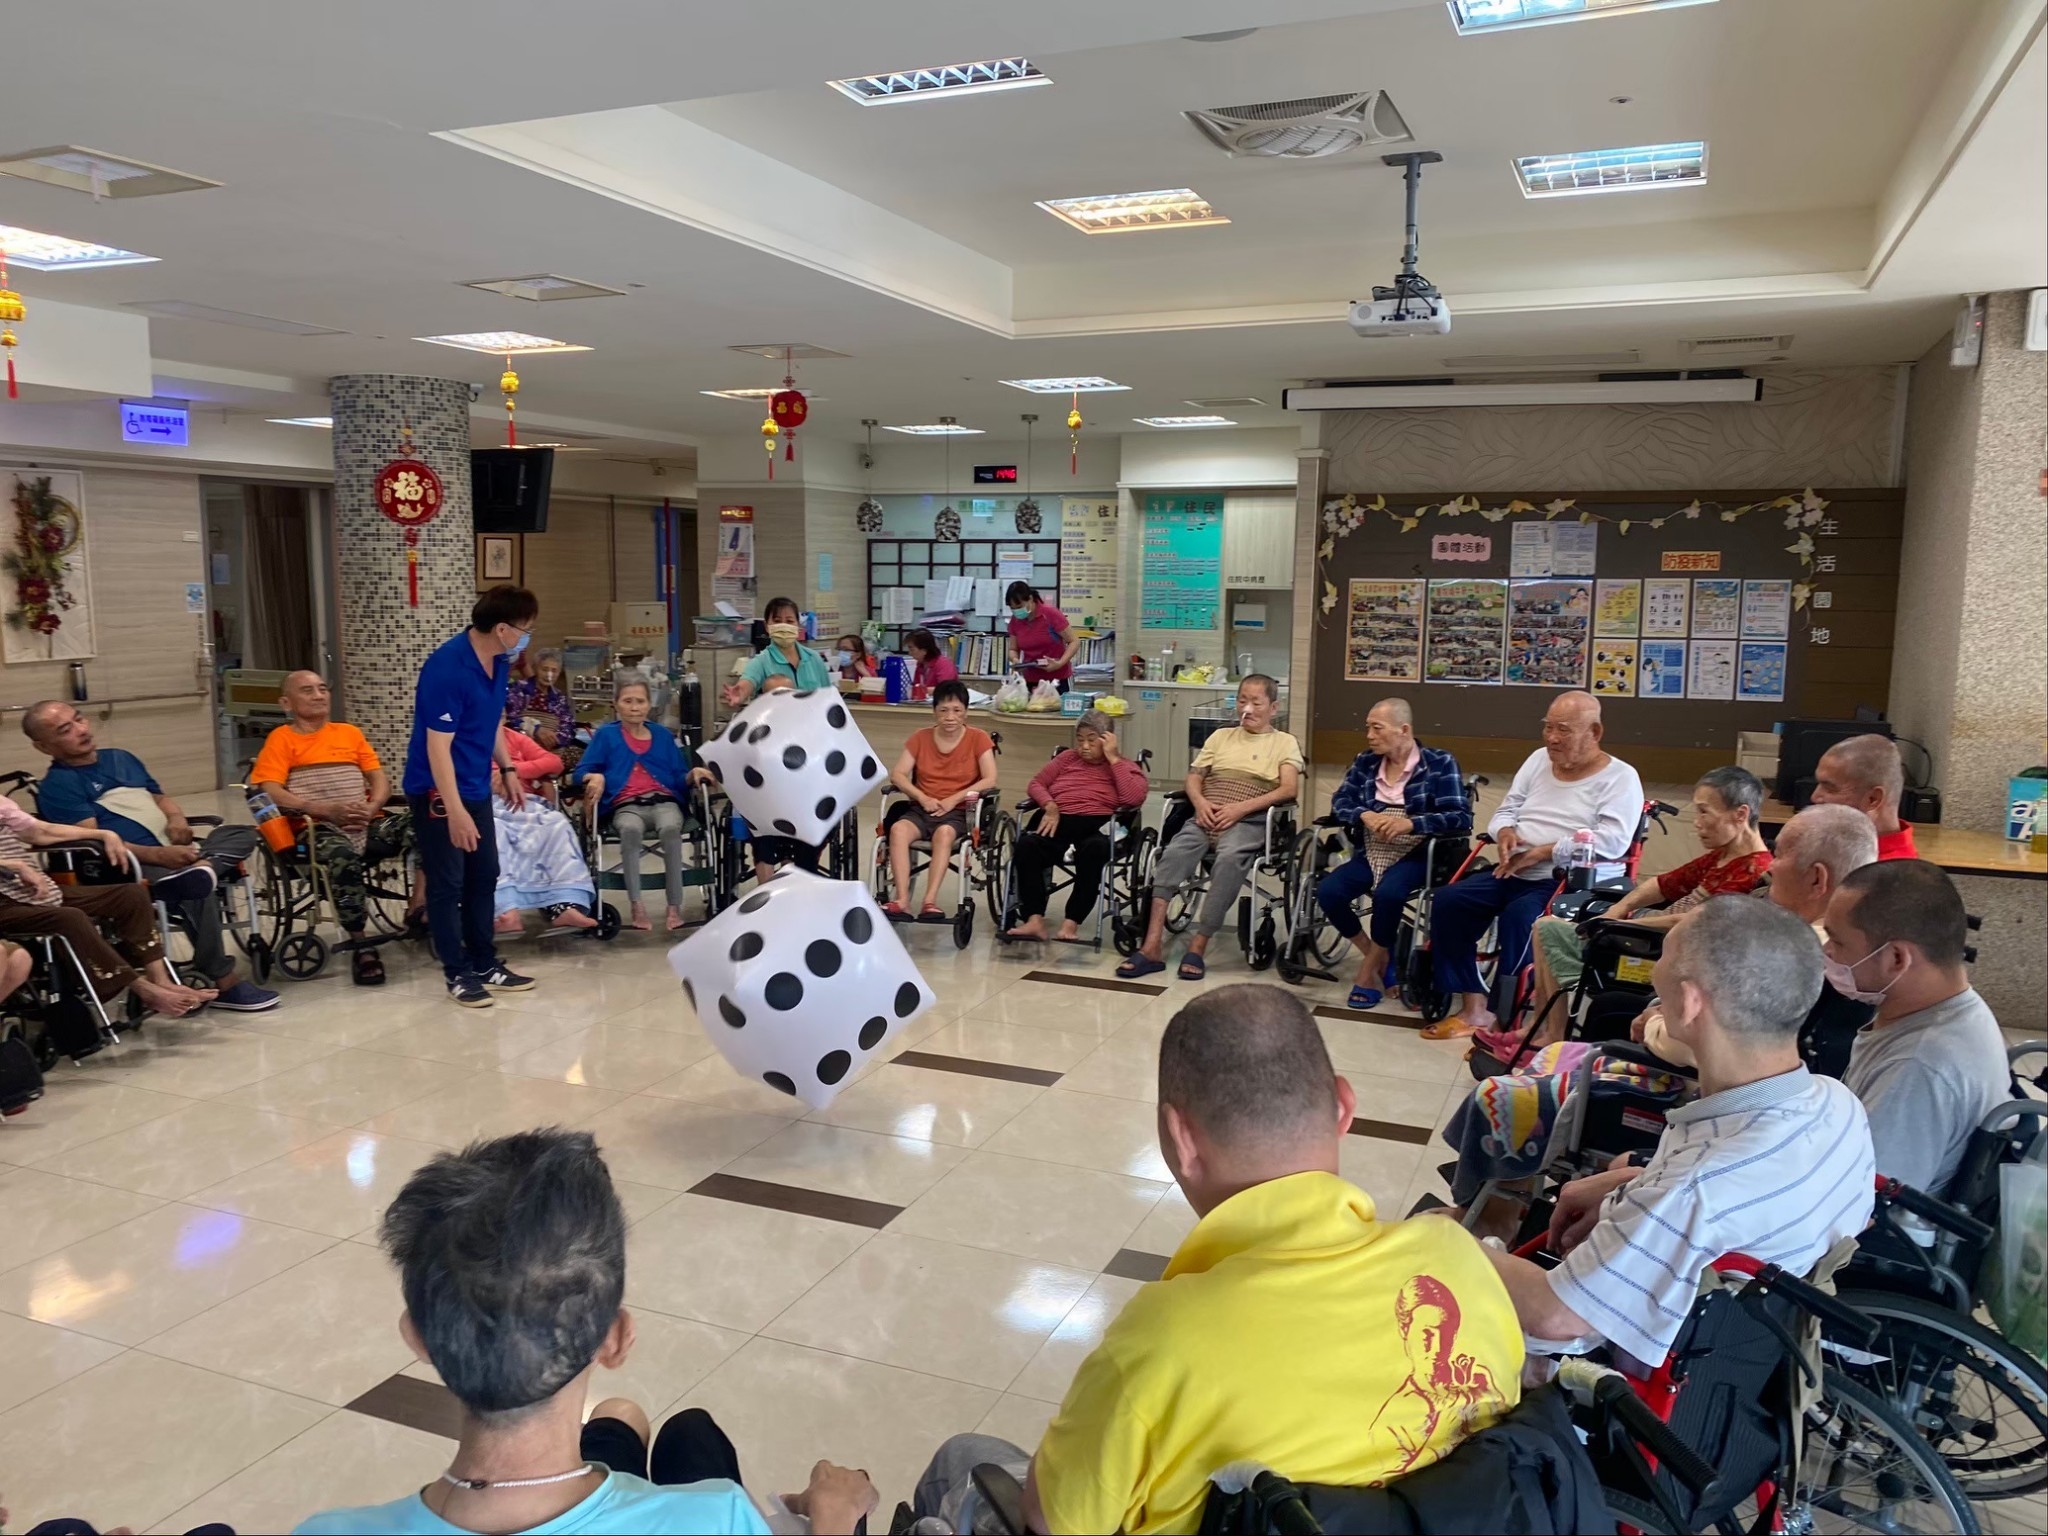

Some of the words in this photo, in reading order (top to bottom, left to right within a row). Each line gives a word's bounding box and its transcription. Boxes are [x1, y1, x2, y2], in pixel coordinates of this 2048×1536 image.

[393, 471, 424, 501] 福
[1437, 541, 1486, 554] 團體活動
[1663, 553, 1719, 569] 防疫新知
